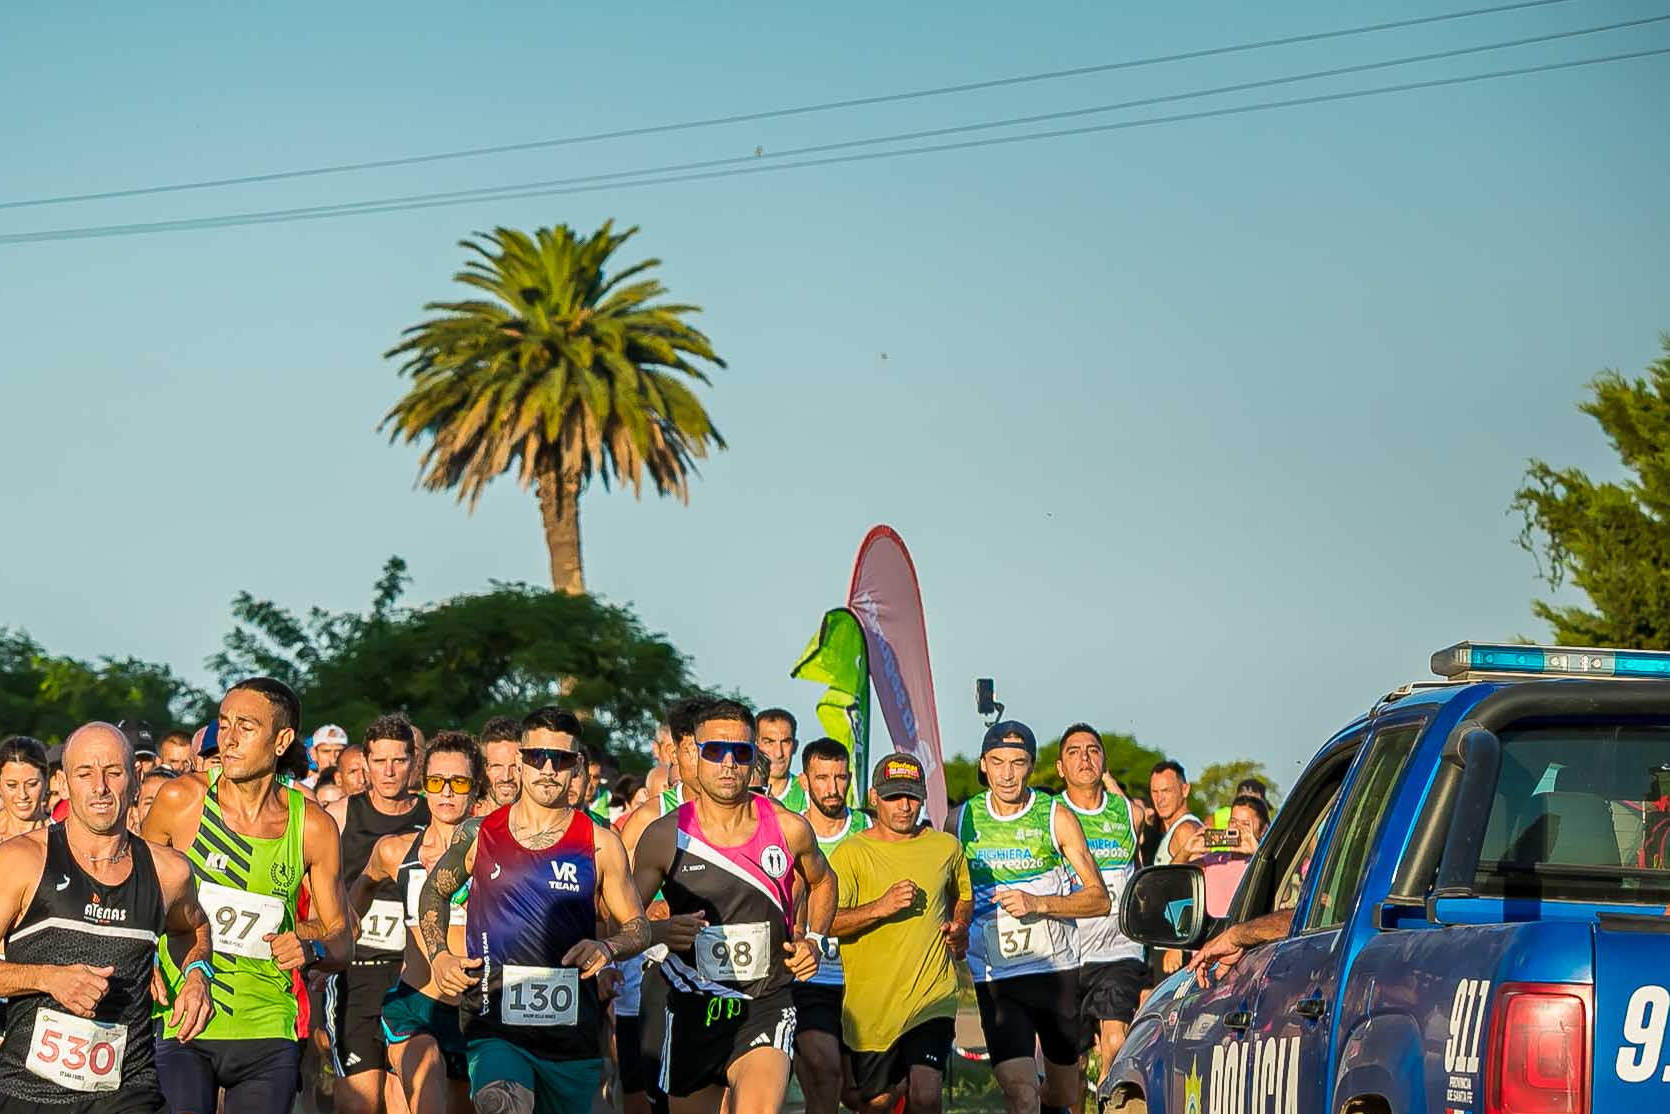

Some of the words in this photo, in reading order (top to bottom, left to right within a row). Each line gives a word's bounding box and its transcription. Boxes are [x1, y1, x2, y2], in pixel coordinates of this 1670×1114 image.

[550, 860, 578, 883] VR
[548, 880, 580, 892] TEAM
[215, 906, 261, 940] 97
[362, 914, 399, 938] 17
[711, 941, 753, 968] 98
[1001, 927, 1032, 954] 37
[509, 983, 573, 1012] 130
[1444, 978, 1491, 1073] 911
[1615, 984, 1670, 1082] 9
[36, 1028, 116, 1075] 530
